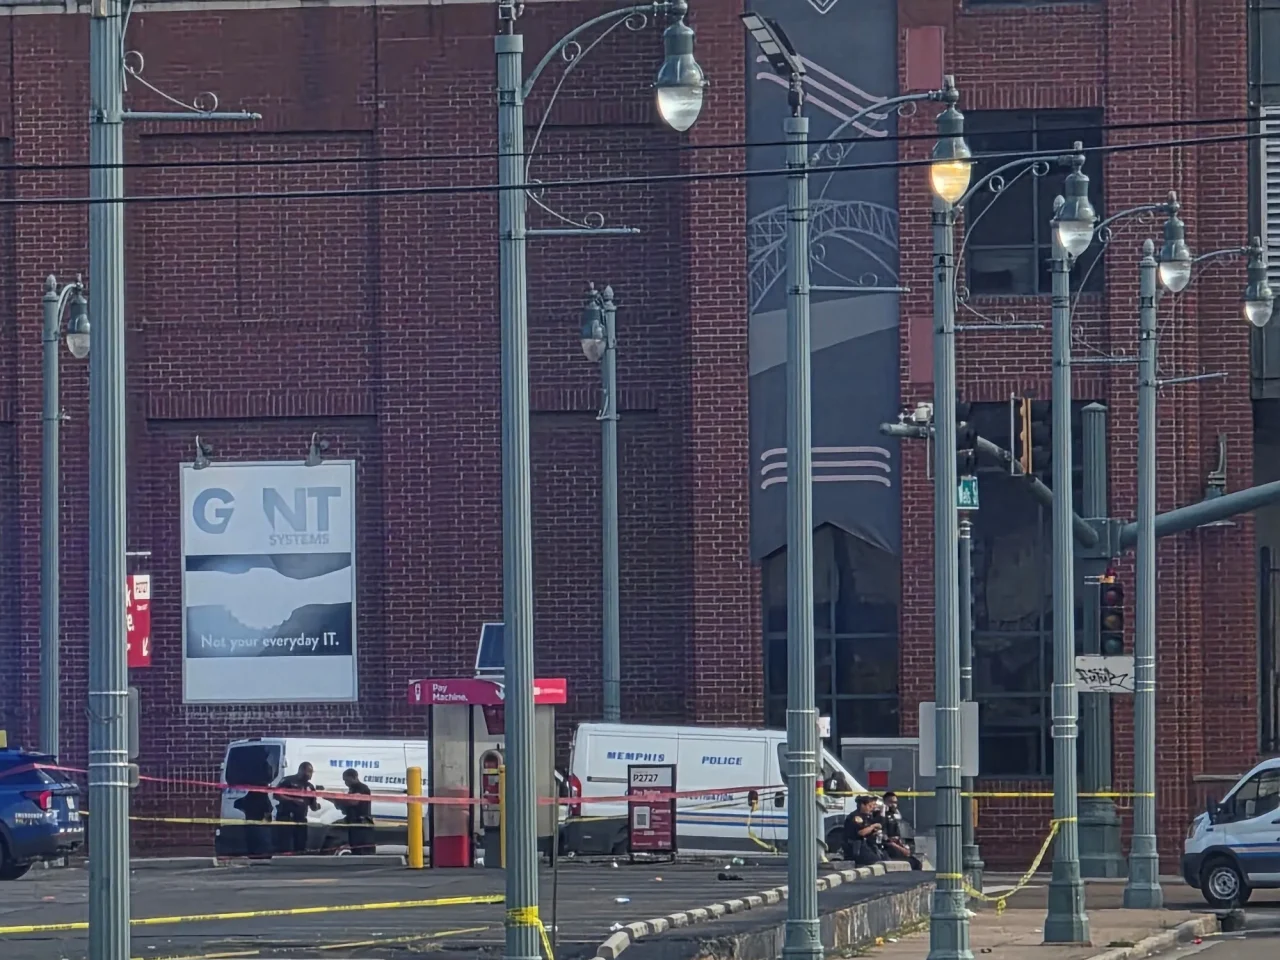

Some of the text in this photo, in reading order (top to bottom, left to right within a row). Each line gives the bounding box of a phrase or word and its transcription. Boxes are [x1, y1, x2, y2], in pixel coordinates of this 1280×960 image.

[269, 533, 330, 546] SYSTEMS
[200, 632, 340, 652] Not your everyday IT.
[432, 683, 448, 694] Pay
[329, 759, 380, 769] MEMPHIS
[606, 751, 743, 766] MEMPHIS POLICE
[363, 775, 384, 783] CRIME
[633, 774, 659, 782] P2727
